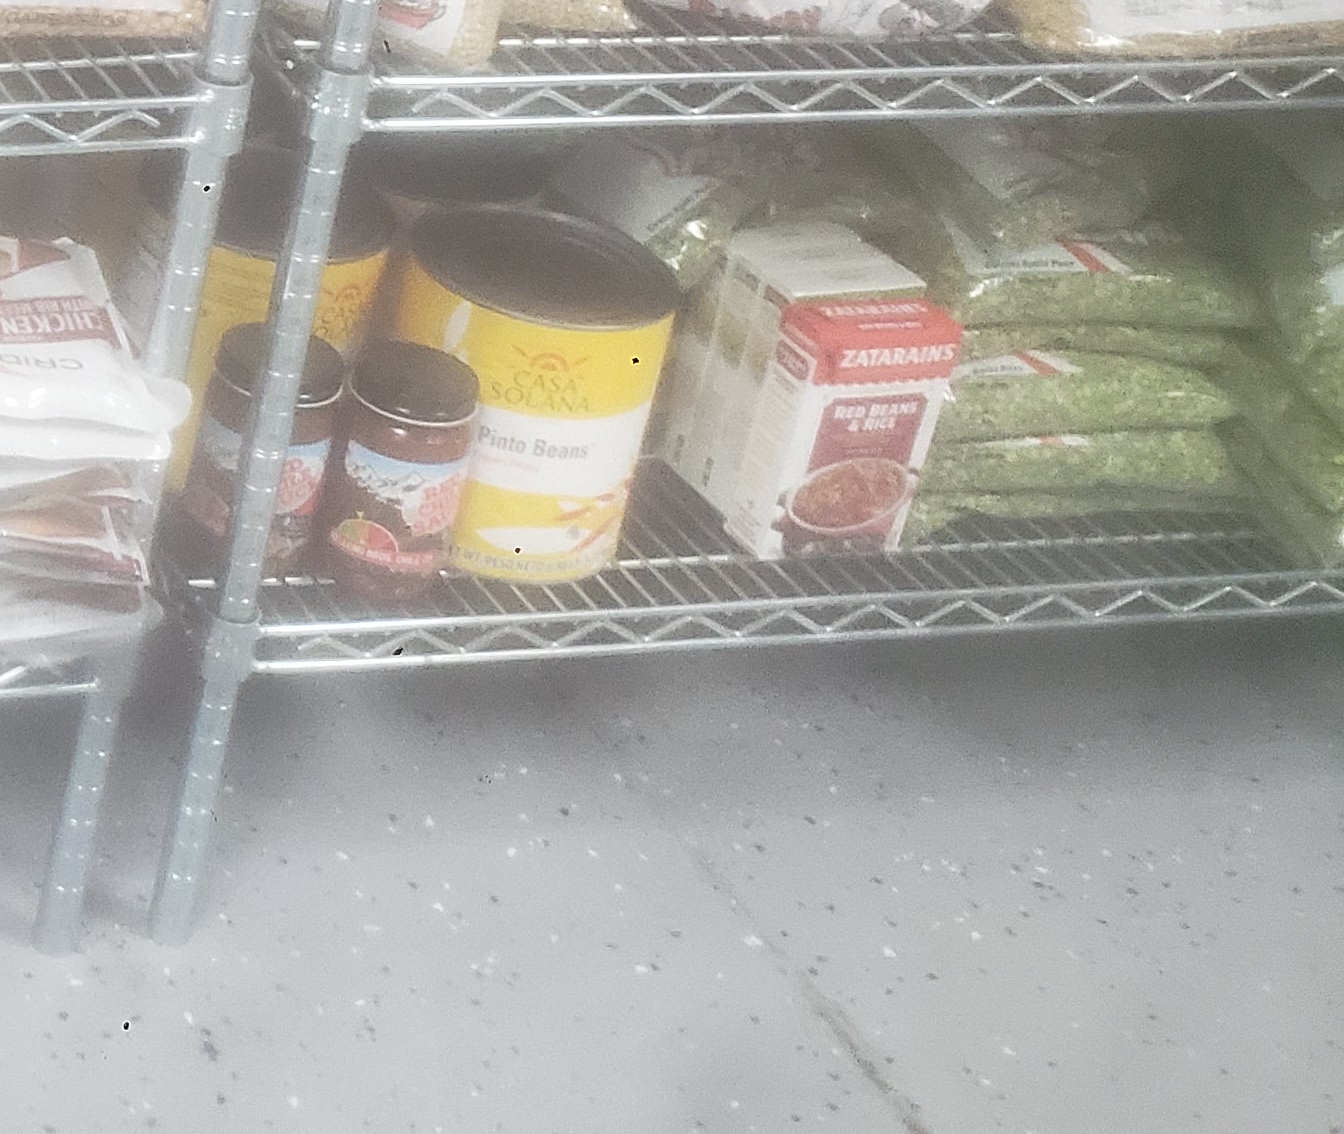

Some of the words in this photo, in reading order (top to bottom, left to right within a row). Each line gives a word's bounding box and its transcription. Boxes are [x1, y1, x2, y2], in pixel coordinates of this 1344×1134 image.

[0, 311, 103, 335] CHICKEN
[513, 369, 578, 395] CASA
[490, 380, 591, 414] SOLANA
[833, 404, 867, 420] RED
[868, 400, 919, 418] BEANS
[476, 424, 527, 455] Pinto
[532, 437, 589, 460] Beans
